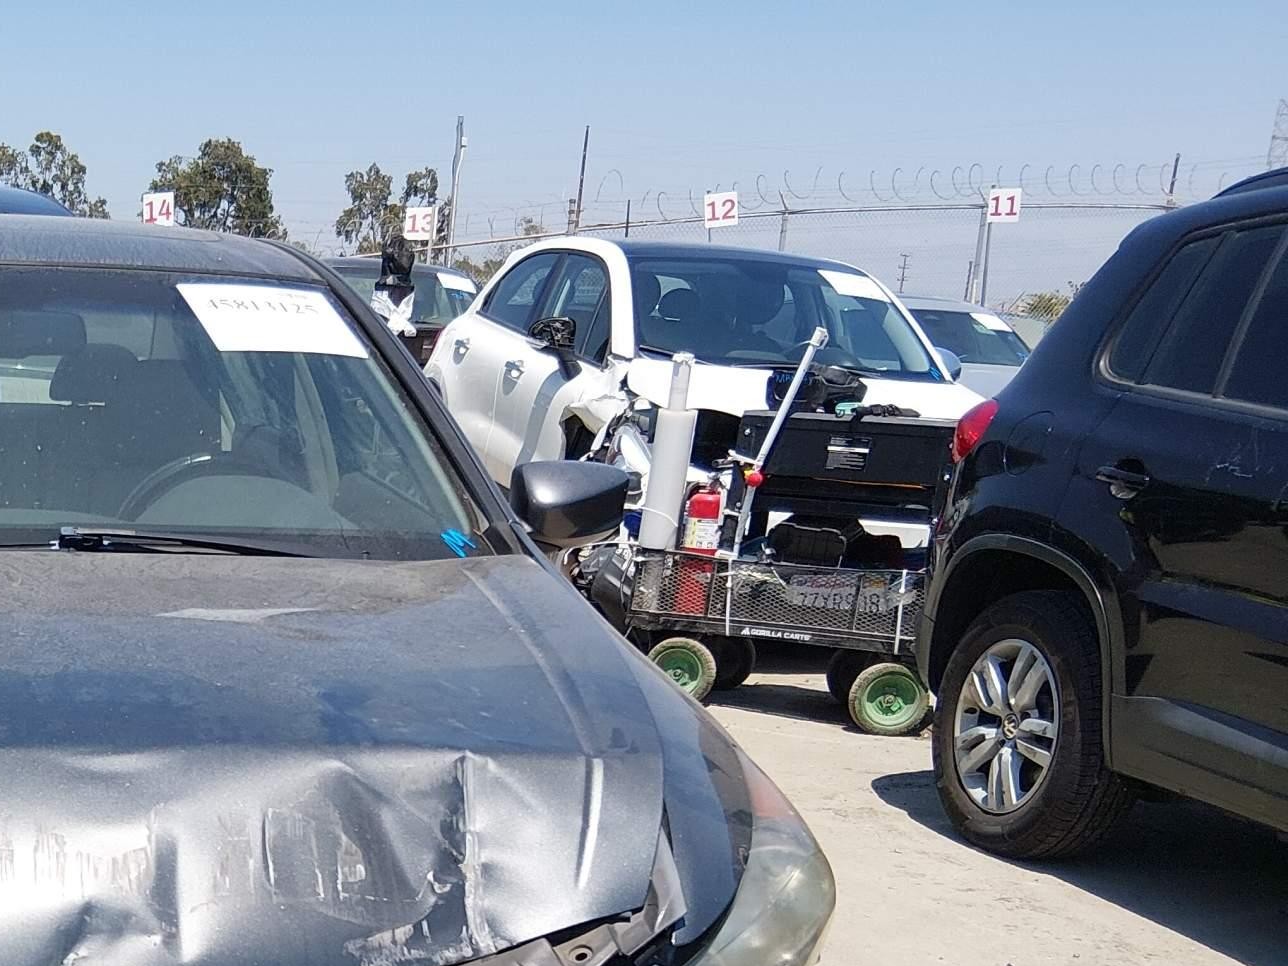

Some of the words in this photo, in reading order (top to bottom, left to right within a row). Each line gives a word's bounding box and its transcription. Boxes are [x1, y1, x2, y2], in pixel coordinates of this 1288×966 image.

[144, 199, 172, 225] 14
[706, 199, 736, 222] 12
[989, 195, 1018, 217] 11
[406, 213, 432, 234] 13
[750, 628, 782, 639] GORILLA
[784, 632, 811, 641] CARTS
